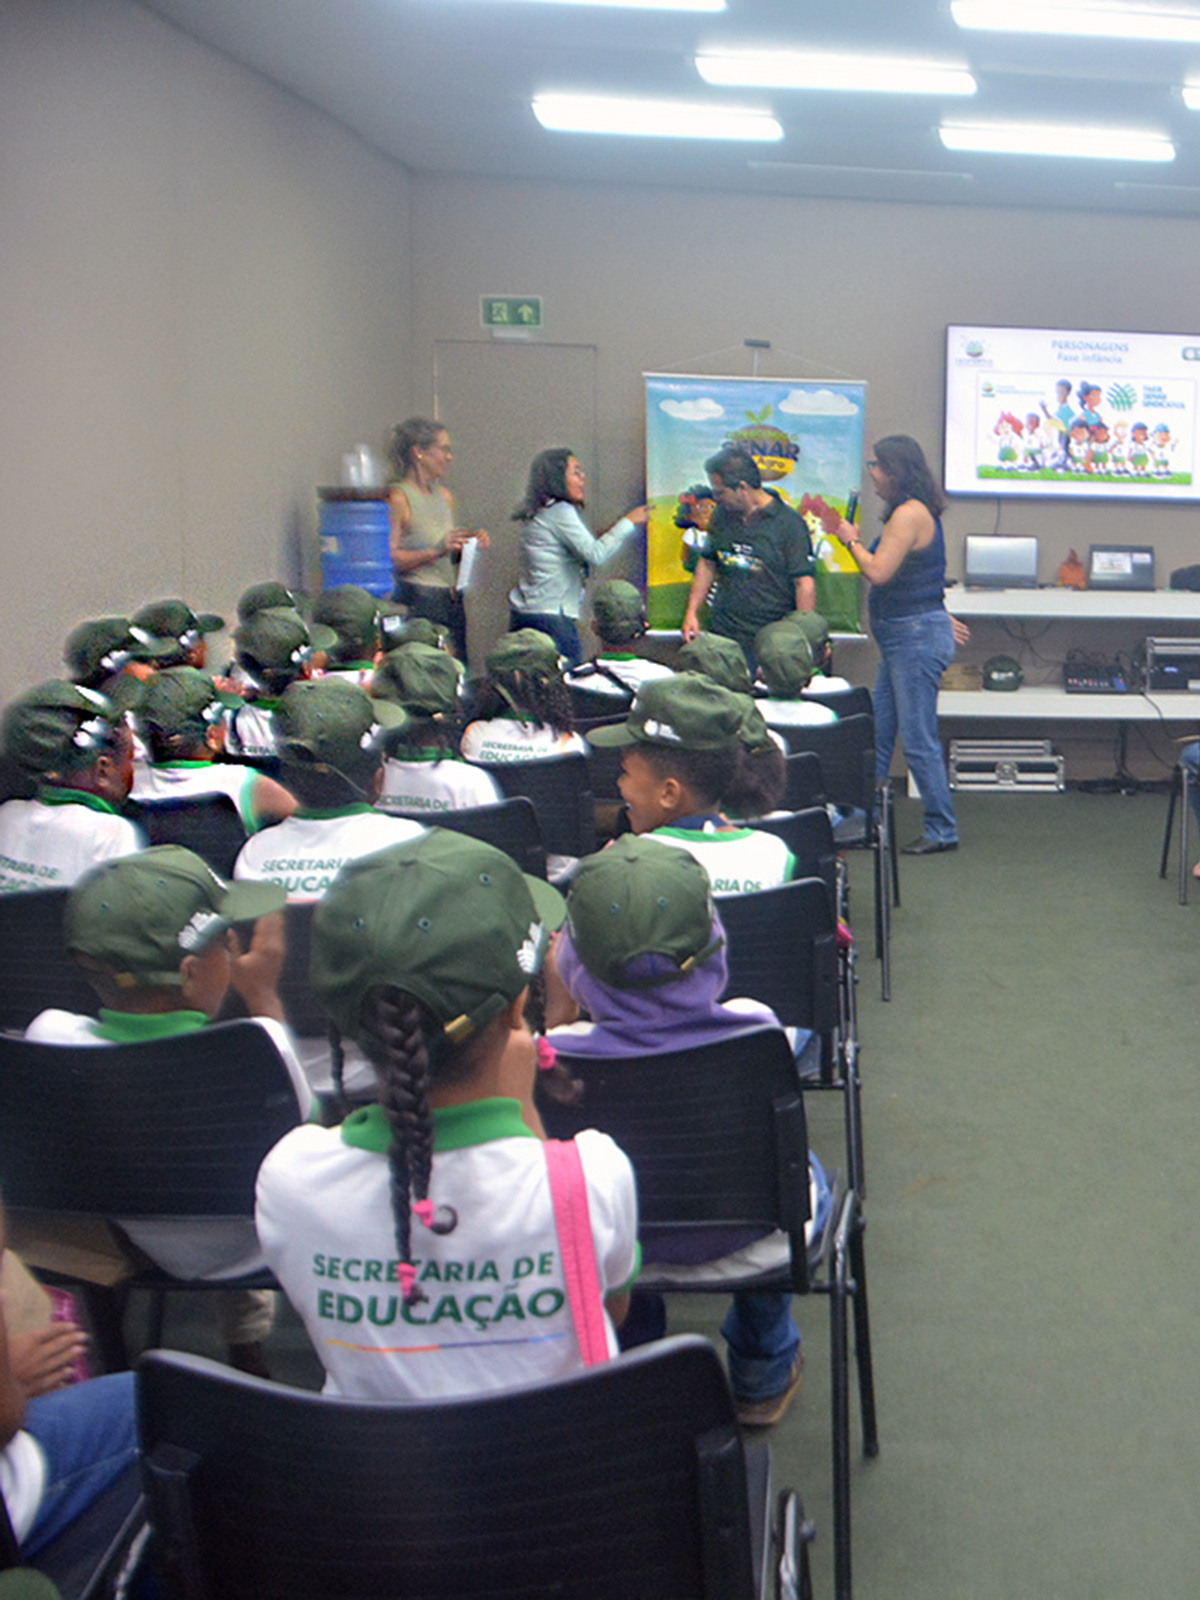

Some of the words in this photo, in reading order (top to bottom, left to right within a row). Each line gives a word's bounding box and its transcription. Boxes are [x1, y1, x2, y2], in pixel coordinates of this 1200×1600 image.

[1051, 339, 1130, 352] PERSONAGENS
[511, 1252, 555, 1280] DE
[316, 1282, 566, 1331] EDUCAÇÃO
